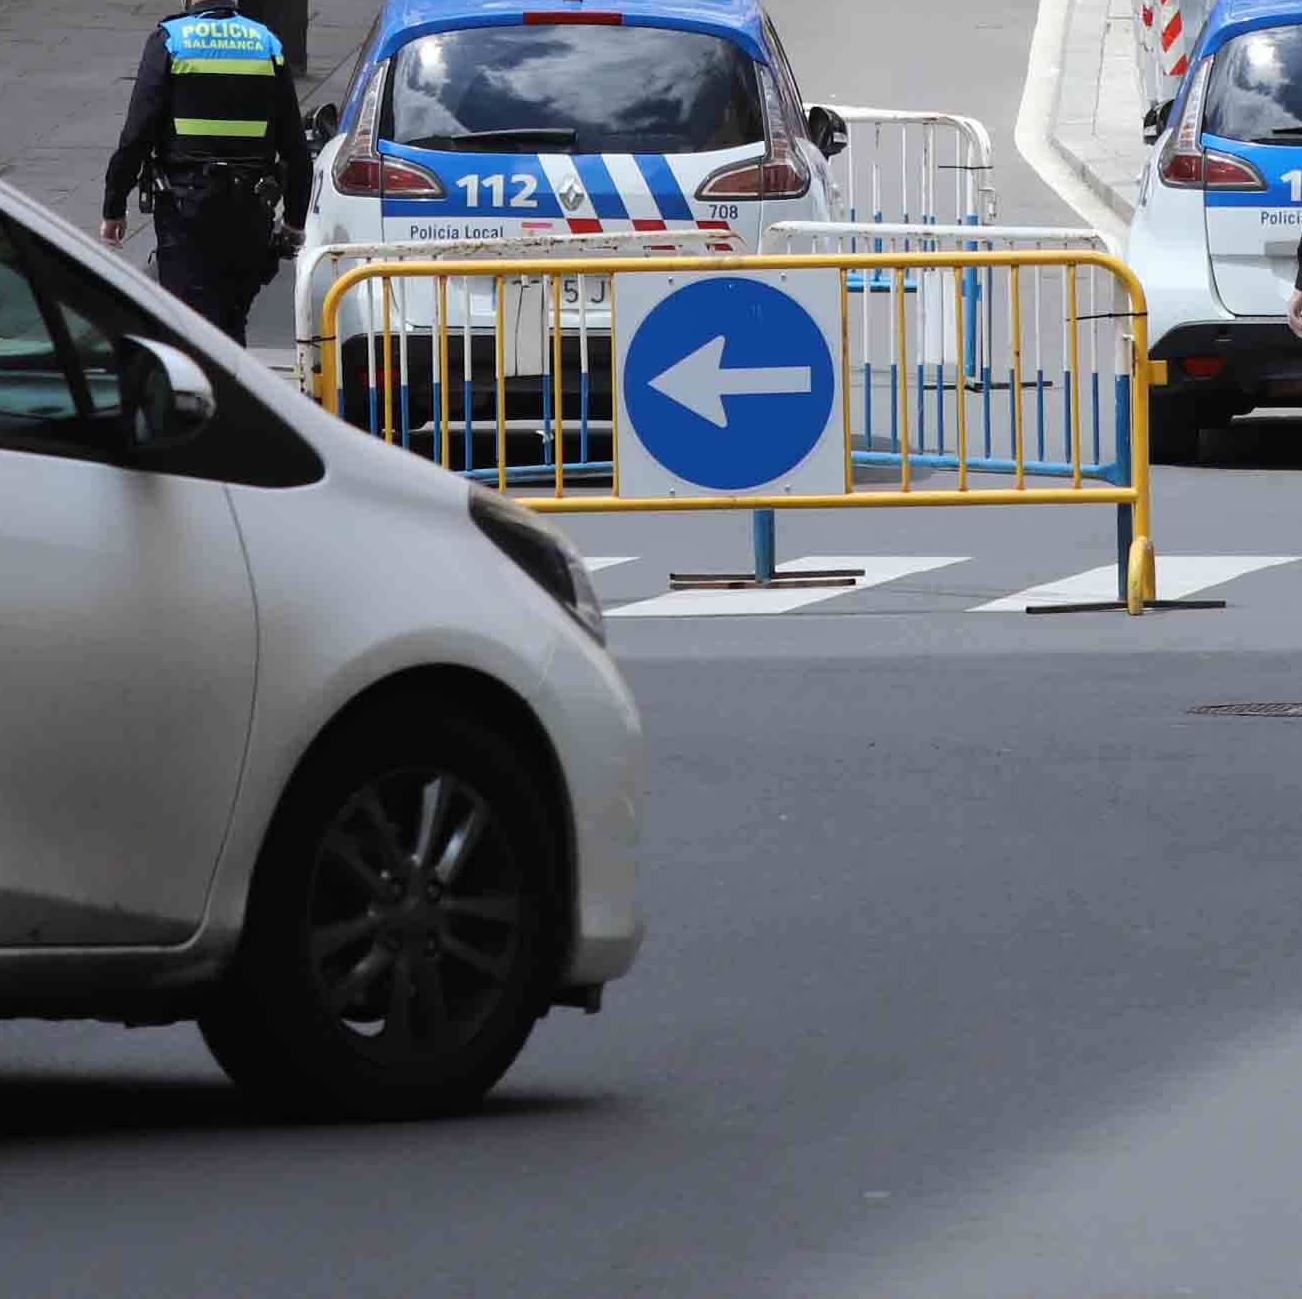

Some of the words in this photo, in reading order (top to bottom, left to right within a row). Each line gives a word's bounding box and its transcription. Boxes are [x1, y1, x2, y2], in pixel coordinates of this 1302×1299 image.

[183, 38, 265, 50] SALAMANCA
[456, 174, 539, 207] 112
[709, 205, 739, 220] 708
[465, 225, 504, 239] Local
